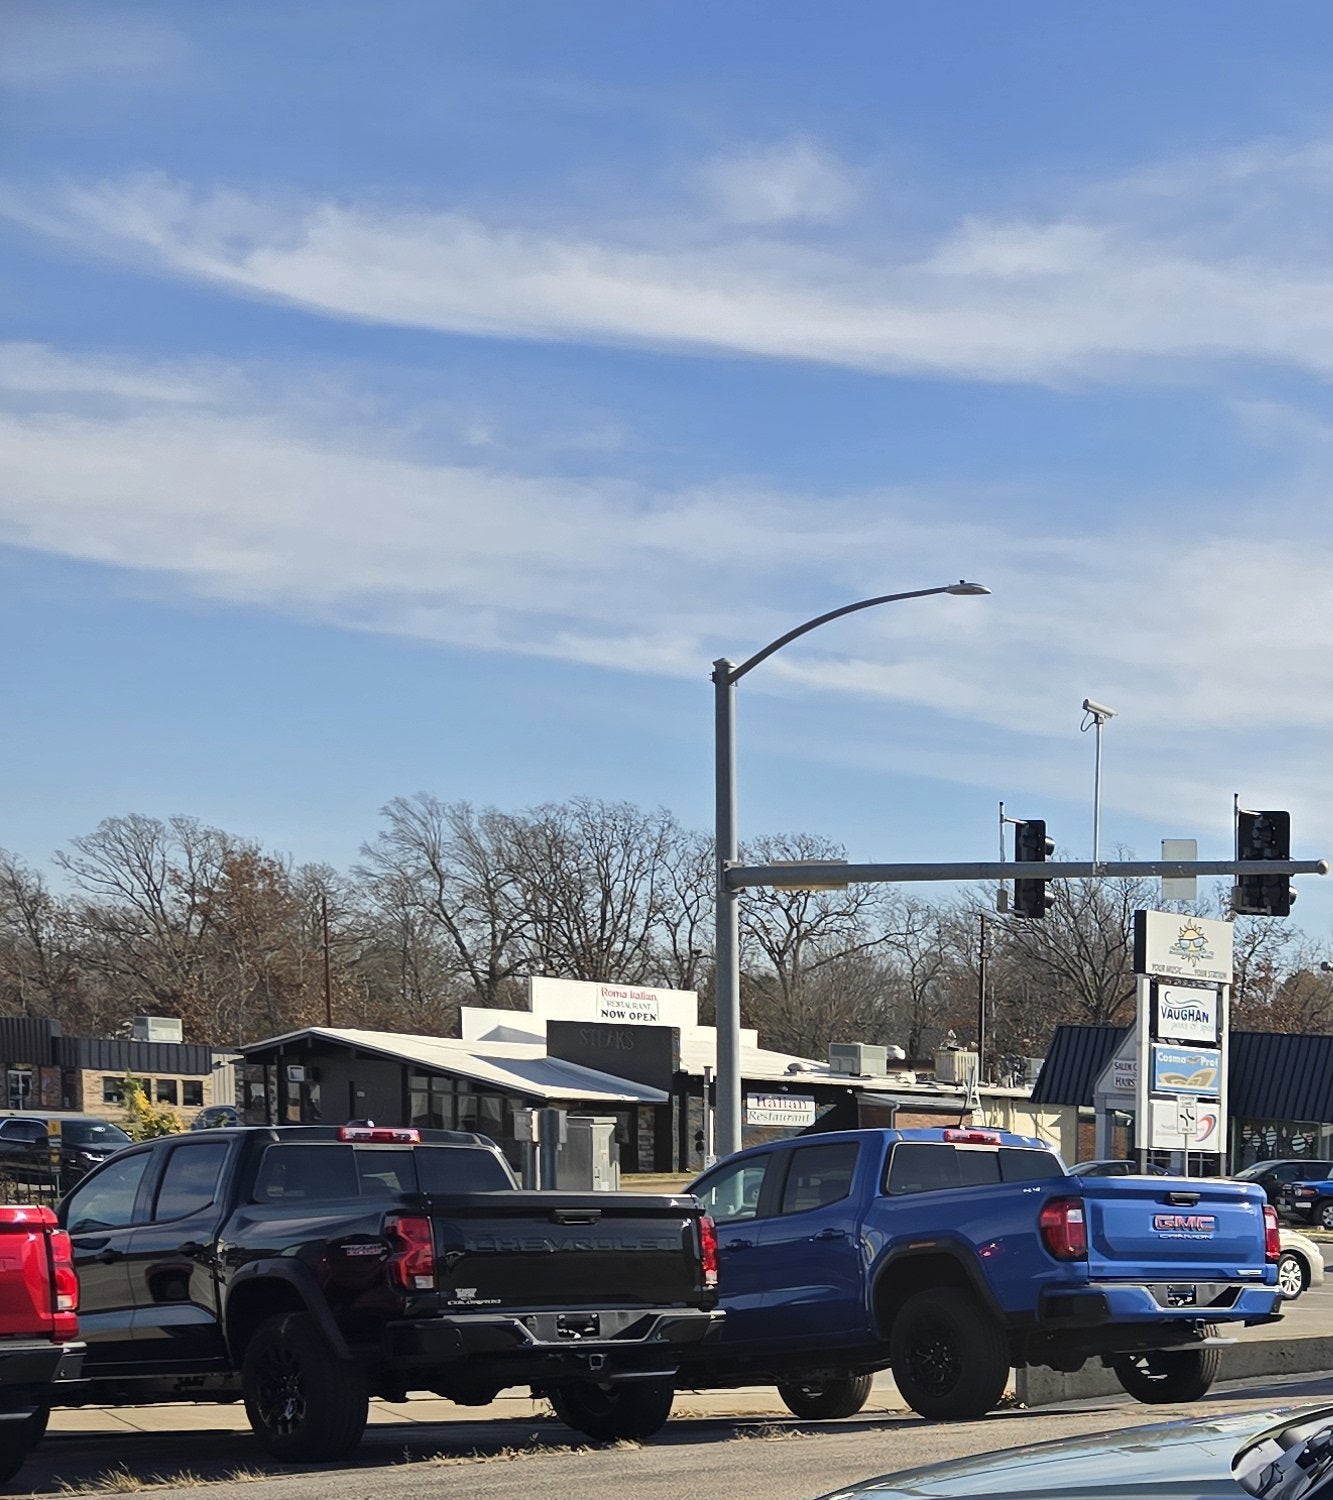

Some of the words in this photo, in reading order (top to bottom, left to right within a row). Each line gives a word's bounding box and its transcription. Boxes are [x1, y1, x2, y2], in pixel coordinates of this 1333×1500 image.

[601, 987, 627, 999] Roma
[601, 1009, 625, 1019] NOW
[629, 1012, 657, 1022] OPEN
[1160, 1005, 1209, 1024] VAUGHAN
[756, 1096, 807, 1109] Italian
[749, 1111, 810, 1122] Restaurant
[1154, 1215, 1216, 1231] GMC
[475, 1236, 679, 1252] CHEVROLET
